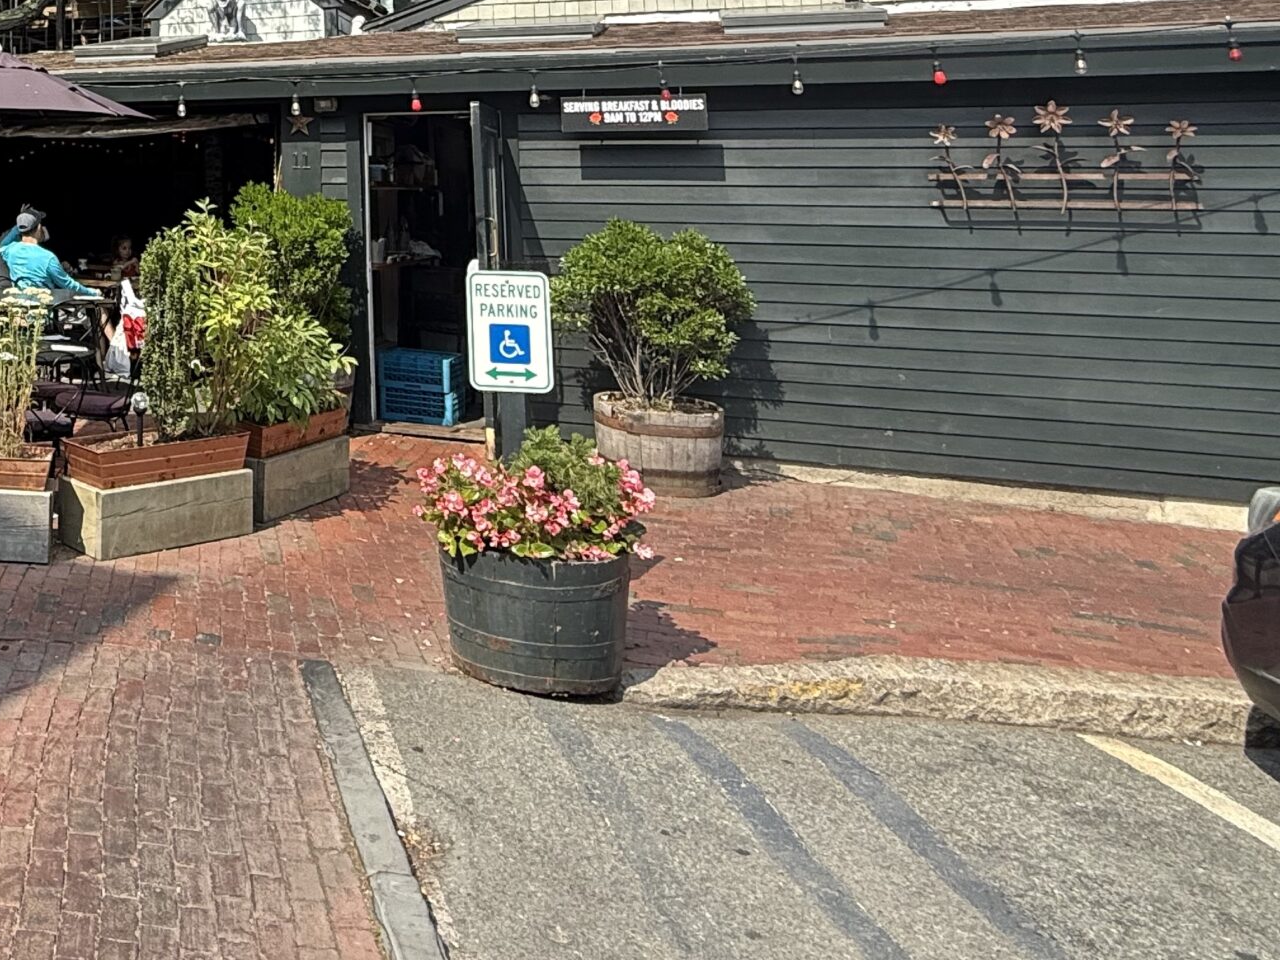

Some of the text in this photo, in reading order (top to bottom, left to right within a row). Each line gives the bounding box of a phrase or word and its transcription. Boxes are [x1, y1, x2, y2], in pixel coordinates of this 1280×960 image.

[563, 98, 705, 113] SERVING BREAKFAST & BLOODIES
[603, 111, 662, 123] 9AM TO 12PM
[292, 151, 312, 170] 11
[475, 283, 541, 299] RESERVED
[479, 303, 538, 319] PARKING
